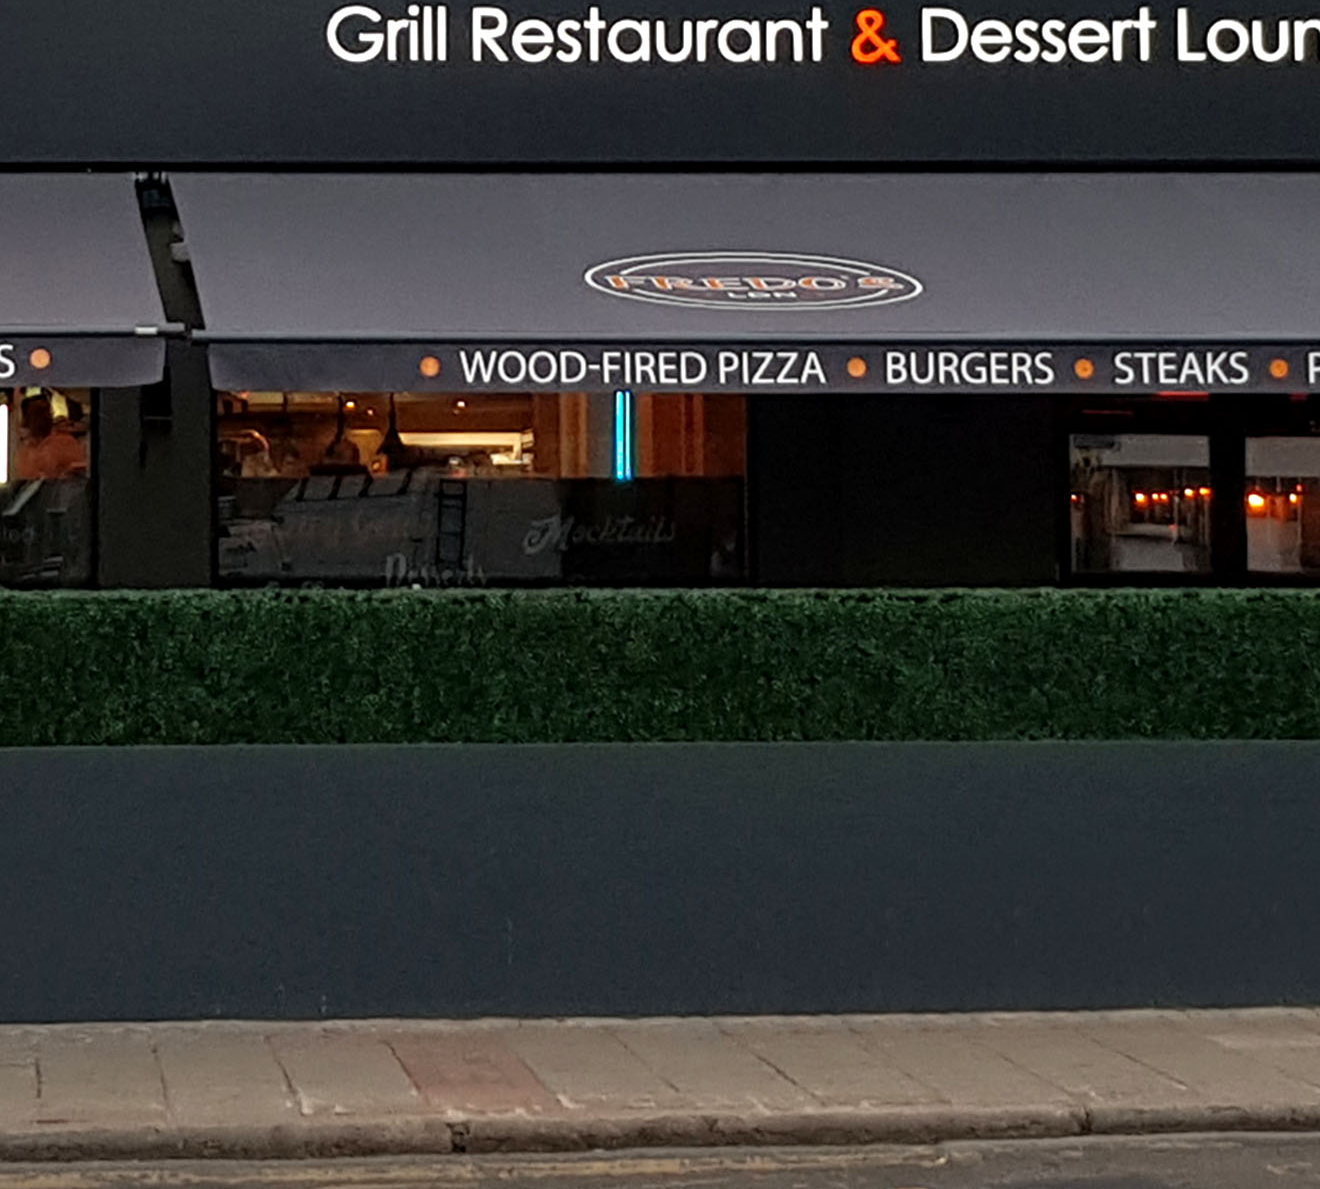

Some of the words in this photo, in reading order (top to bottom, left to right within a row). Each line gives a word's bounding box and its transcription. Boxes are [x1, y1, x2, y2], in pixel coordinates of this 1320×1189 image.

[327, 5, 446, 62] Grill
[472, 7, 829, 63] Restaurant
[850, 8, 901, 64] &
[922, 7, 1157, 63] Dessert
[604, 273, 904, 291] FREDO'S
[727, 291, 797, 299] LDN
[460, 351, 706, 384] WOOD-FIRED
[719, 351, 827, 384] PIZZA
[886, 352, 1055, 384] BURGERS
[1114, 351, 1249, 385] STEAKS
